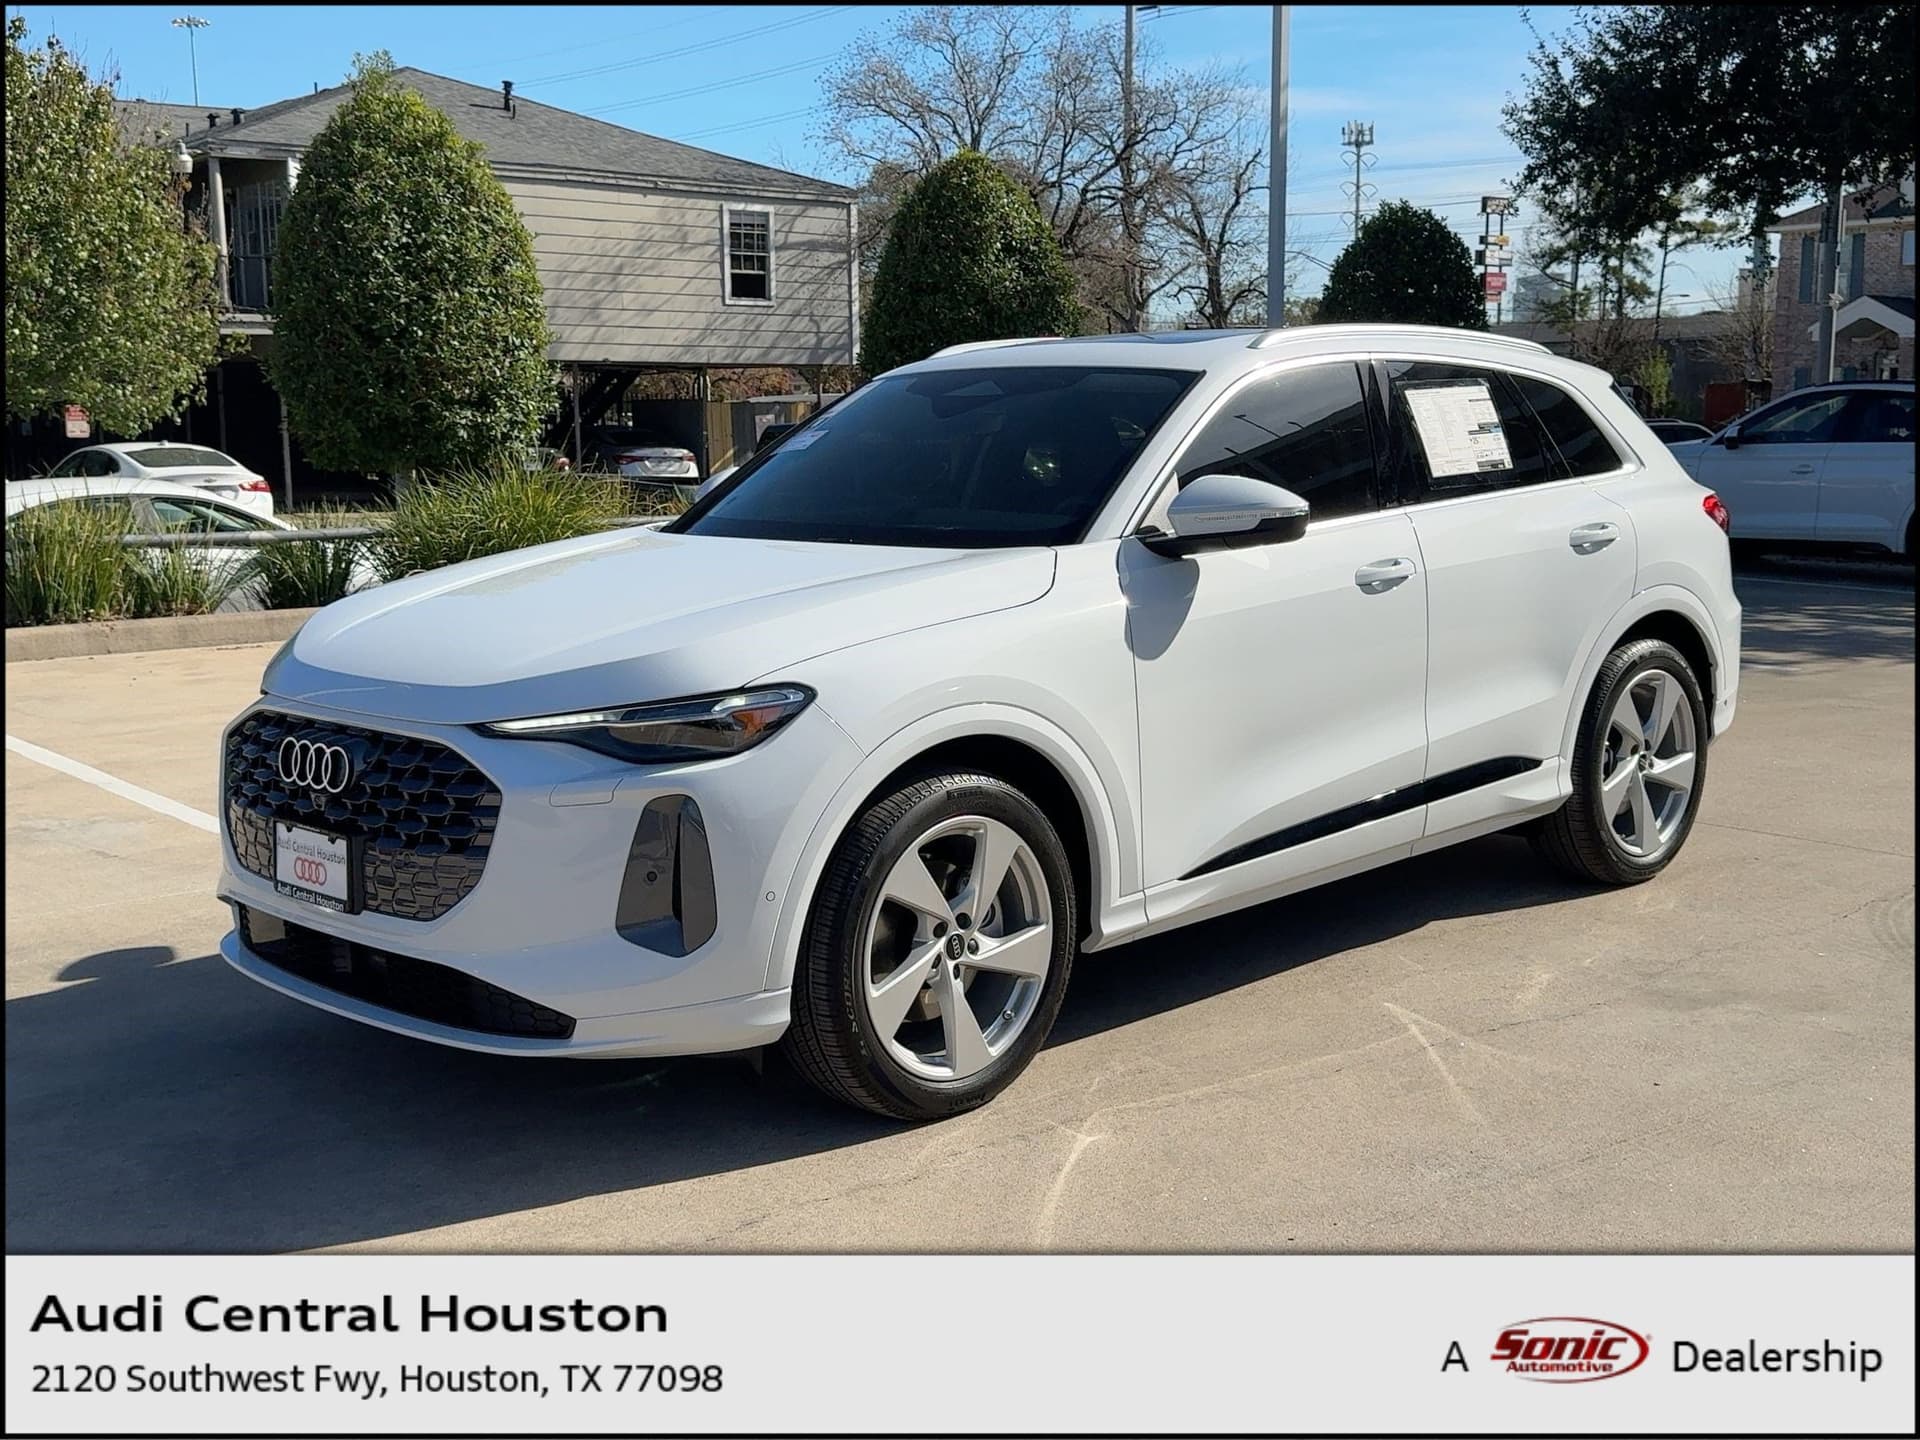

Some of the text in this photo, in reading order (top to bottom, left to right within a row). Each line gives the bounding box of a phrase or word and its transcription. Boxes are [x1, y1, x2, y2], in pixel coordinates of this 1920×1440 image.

[277, 837, 346, 866] Audi Central Houston
[277, 883, 345, 912] Audi Central Houston
